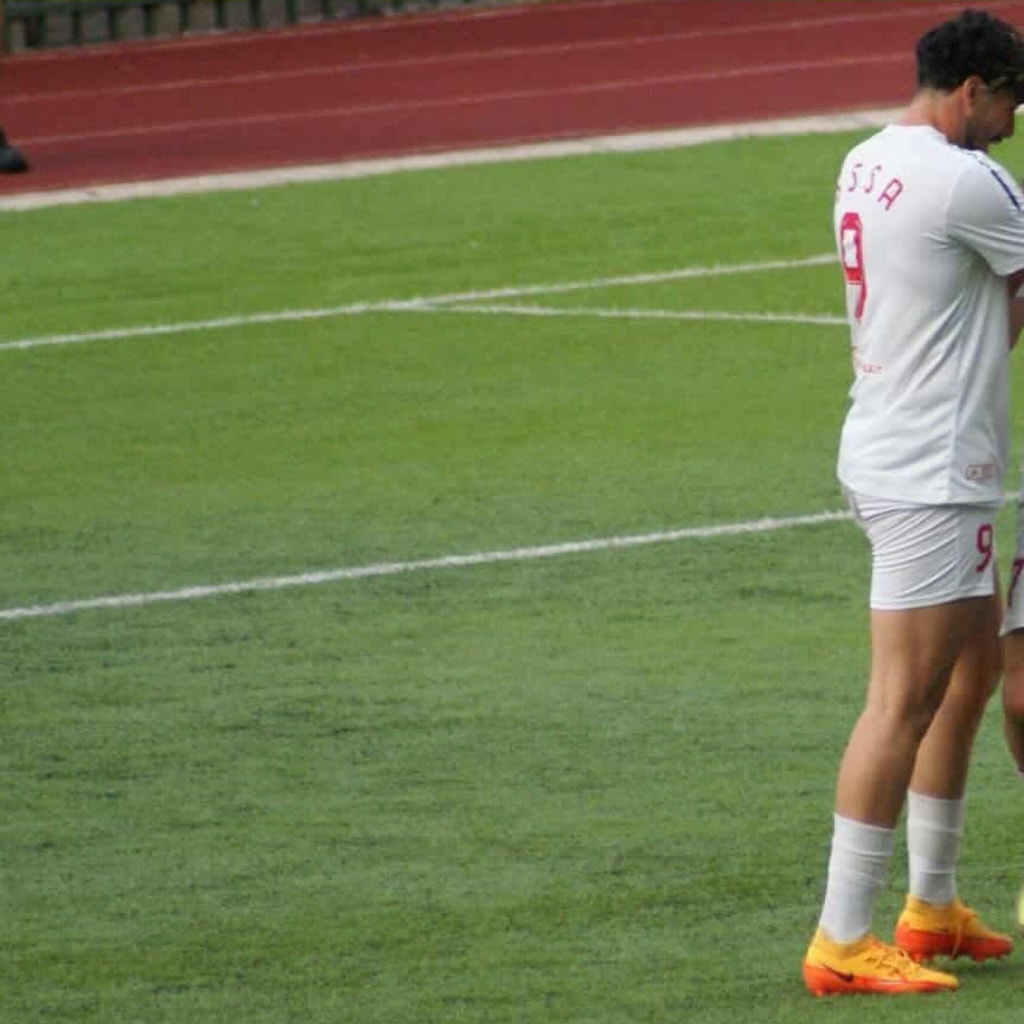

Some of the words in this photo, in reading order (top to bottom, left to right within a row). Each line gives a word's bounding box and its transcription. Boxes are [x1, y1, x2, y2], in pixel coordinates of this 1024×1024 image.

[836, 162, 904, 212] SSA
[840, 211, 867, 319] 9
[975, 523, 993, 573] 9
[1007, 556, 1024, 608] 7
